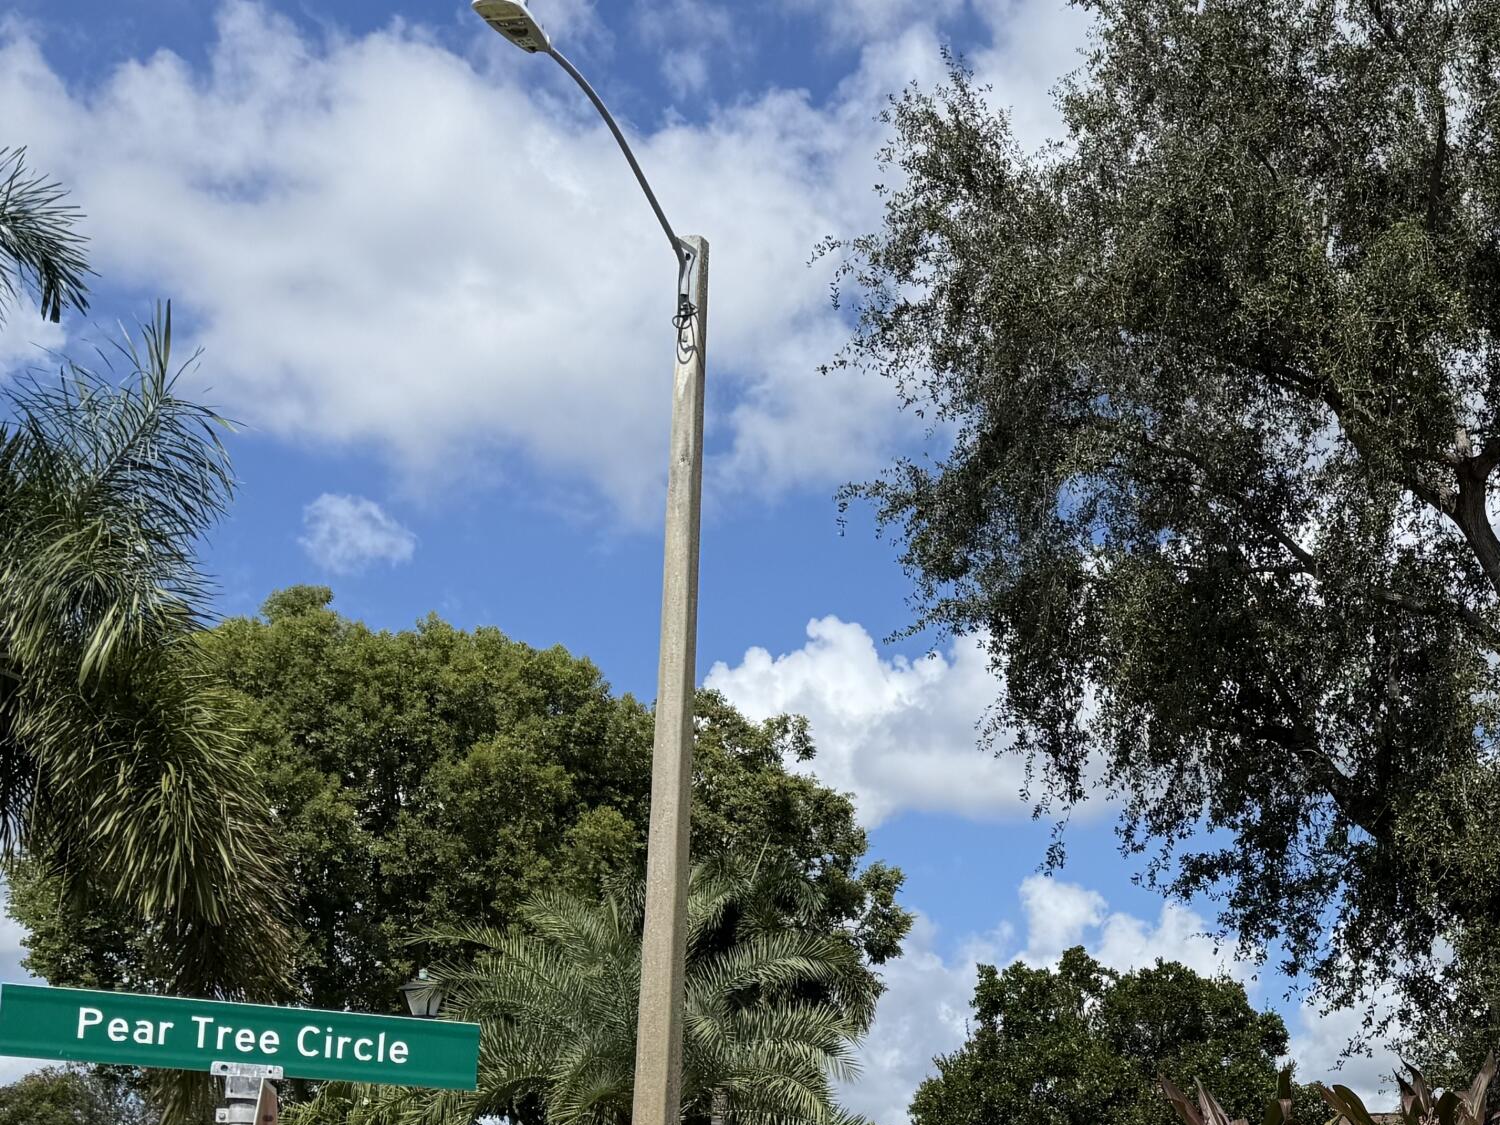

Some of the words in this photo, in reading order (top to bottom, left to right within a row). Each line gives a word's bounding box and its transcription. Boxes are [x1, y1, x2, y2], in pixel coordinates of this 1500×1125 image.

[76, 1007, 174, 1046] Pear
[191, 1016, 280, 1054] Tree
[297, 1025, 409, 1064] Circle
